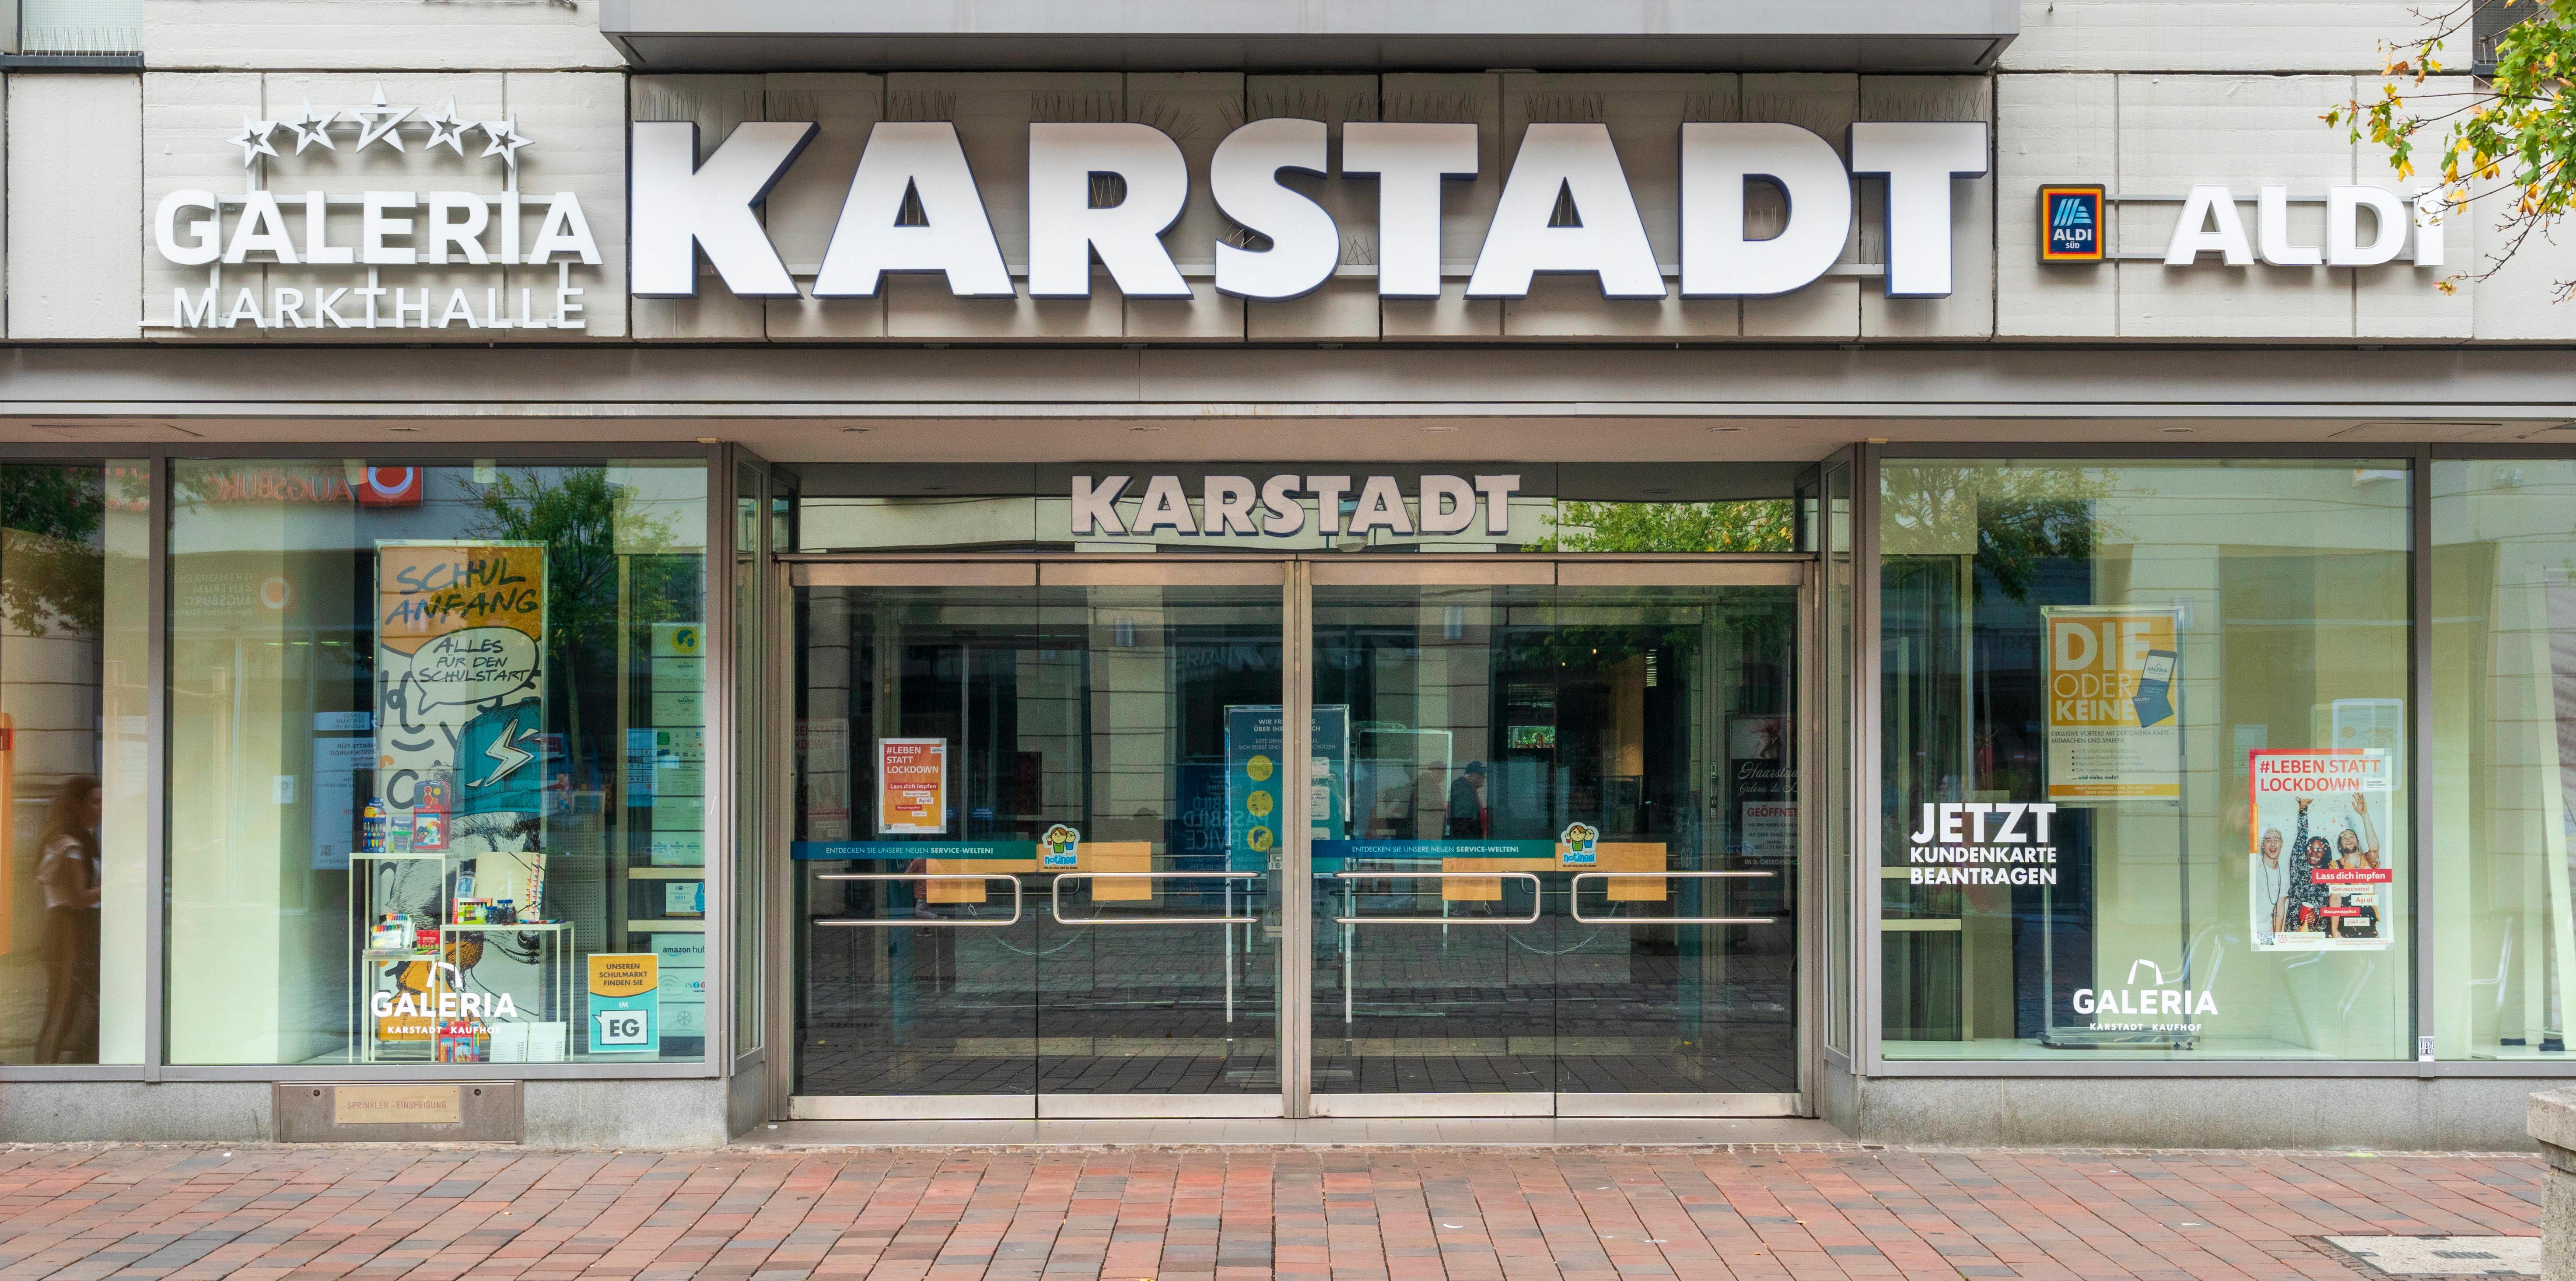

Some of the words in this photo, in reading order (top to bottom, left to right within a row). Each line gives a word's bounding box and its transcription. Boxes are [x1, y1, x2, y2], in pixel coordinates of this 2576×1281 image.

[631, 117, 1988, 302] KARSTADT
[154, 189, 603, 266] GALERIA
[2053, 228, 2092, 241] ALDI
[2163, 184, 2444, 267] ALDI
[173, 287, 587, 329] MARKTHALLE
[1071, 474, 1521, 537] KARSTADT
[397, 557, 526, 595] SCHUL
[385, 588, 539, 625] ANFANG
[433, 637, 504, 654] ALLES
[2055, 623, 2151, 670] DIE
[437, 654, 466, 668] FÜR
[473, 657, 508, 668] DEN
[419, 667, 532, 683] SCHULSTART
[2054, 673, 2133, 698] ODER
[2056, 700, 2134, 721] KEINE
[2260, 760, 2324, 774] #LEBEN
[2329, 760, 2380, 773] STATT
[2261, 777, 2359, 791] LOCKDOWN
[1911, 803, 2056, 844] JETZT
[1045, 855, 1076, 864] notinsel
[1564, 853, 1595, 862] notinsel
[1911, 847, 2056, 863] KUNDENKARTE
[1911, 868, 2056, 885] BEANTRAGEN
[2356, 872, 2385, 881] impfen
[371, 991, 518, 1018] GALERIA
[2073, 988, 2219, 1015] GALERIA
[388, 1026, 443, 1034] KARSTADT
[451, 1026, 501, 1034] KAUFHOF
[610, 1018, 640, 1037] EG
[2152, 1023, 2202, 1032] KAUFHOF
